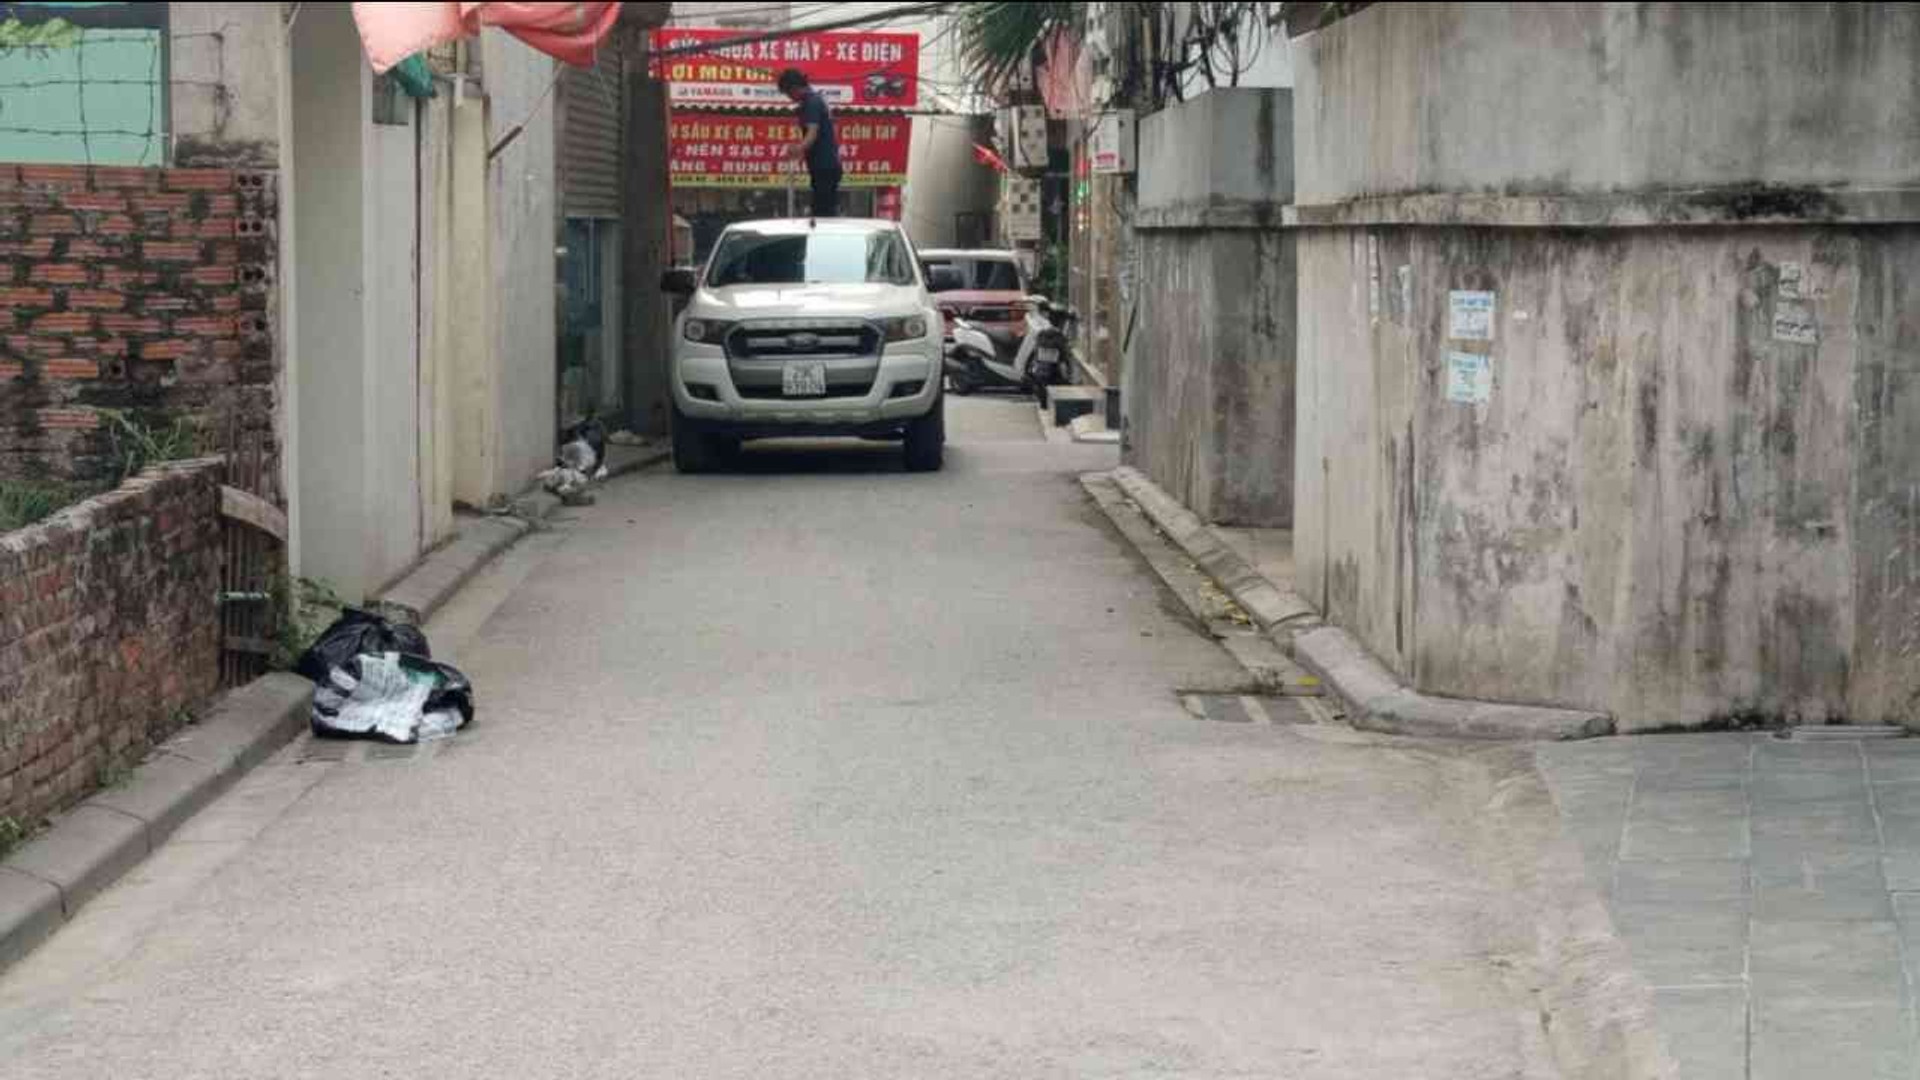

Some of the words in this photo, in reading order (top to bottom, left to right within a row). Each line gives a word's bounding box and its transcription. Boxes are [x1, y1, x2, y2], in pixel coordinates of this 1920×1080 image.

[759, 40, 780, 60] XE
[836, 42, 858, 61] XE
[735, 124, 754, 141] GA
[767, 124, 788, 140] XE
